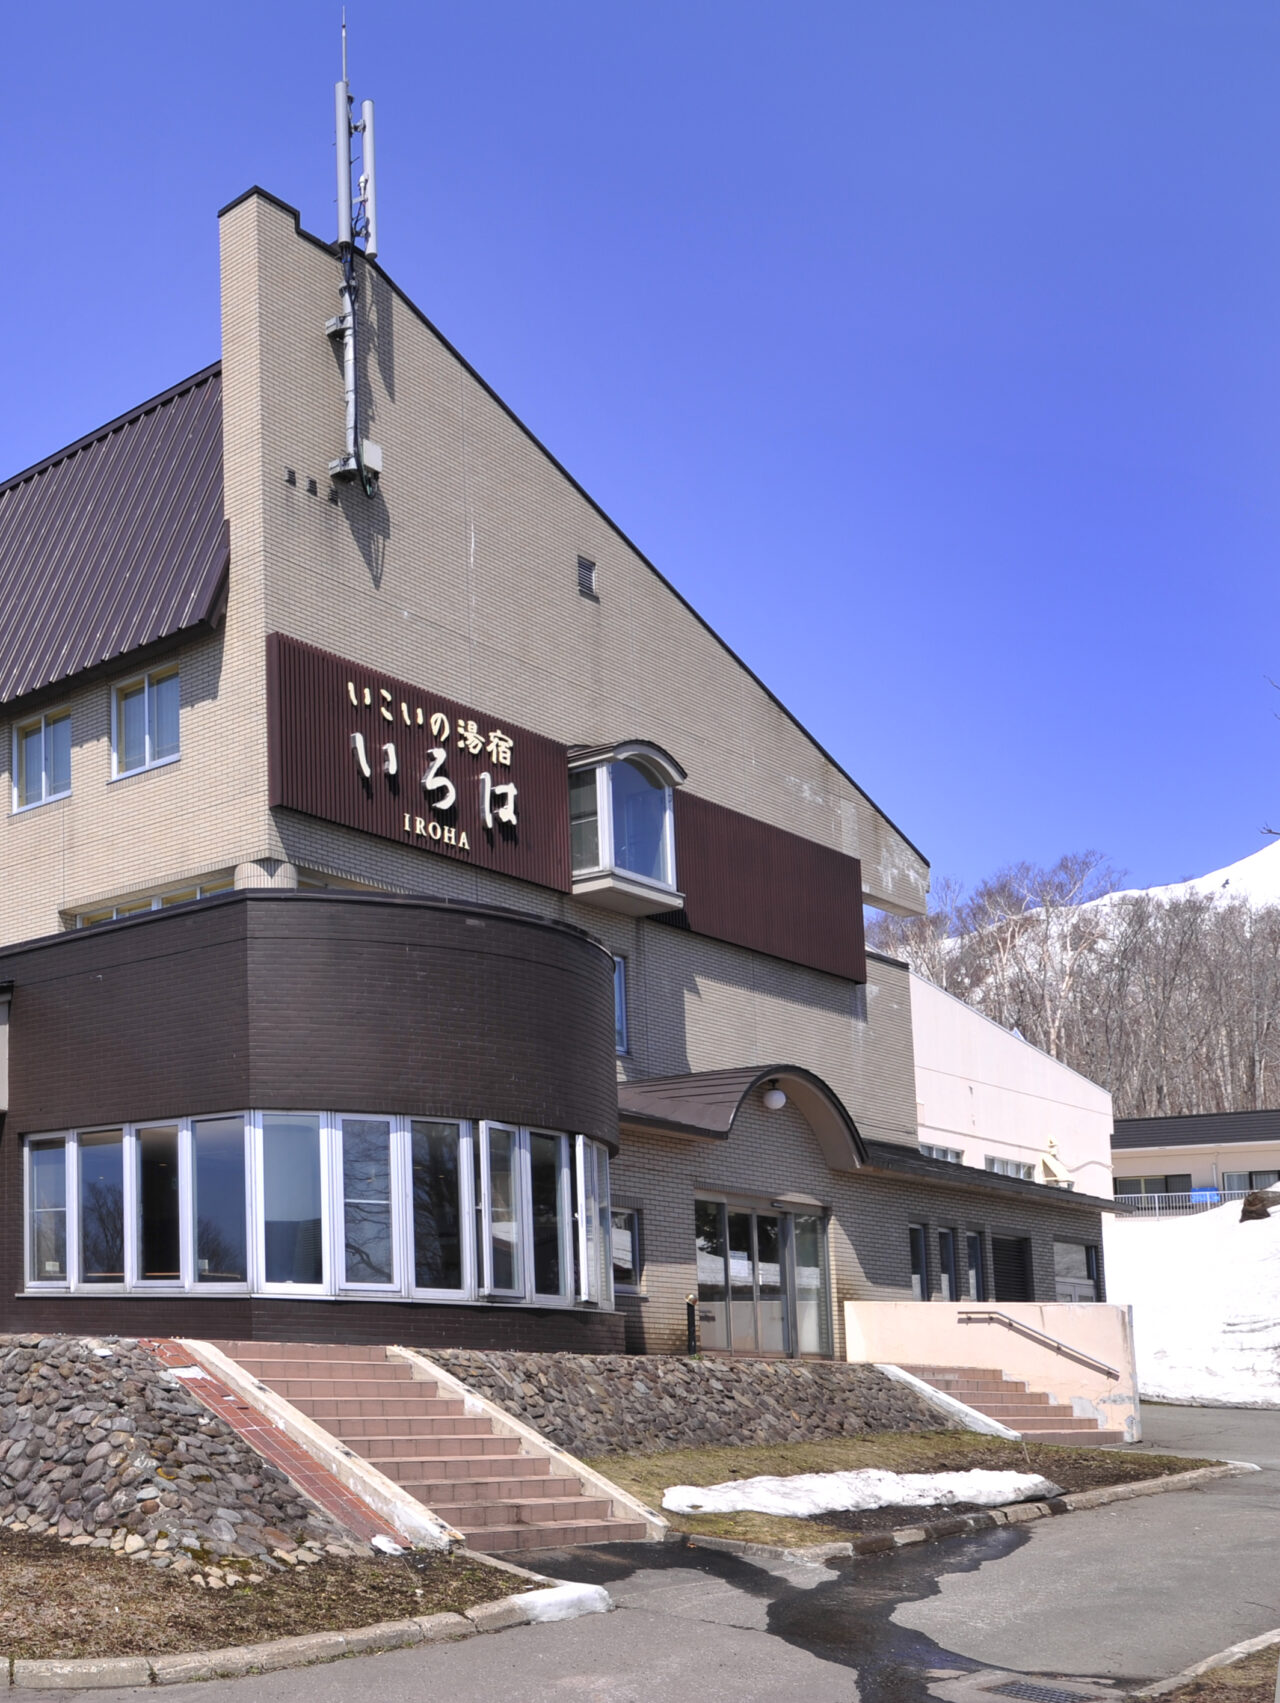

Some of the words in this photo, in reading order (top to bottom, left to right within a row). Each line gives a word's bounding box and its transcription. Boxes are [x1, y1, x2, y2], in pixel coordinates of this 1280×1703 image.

[347, 681, 514, 766] いこいの湯宿
[350, 731, 518, 829] いろは
[403, 812, 471, 850] IROHA
